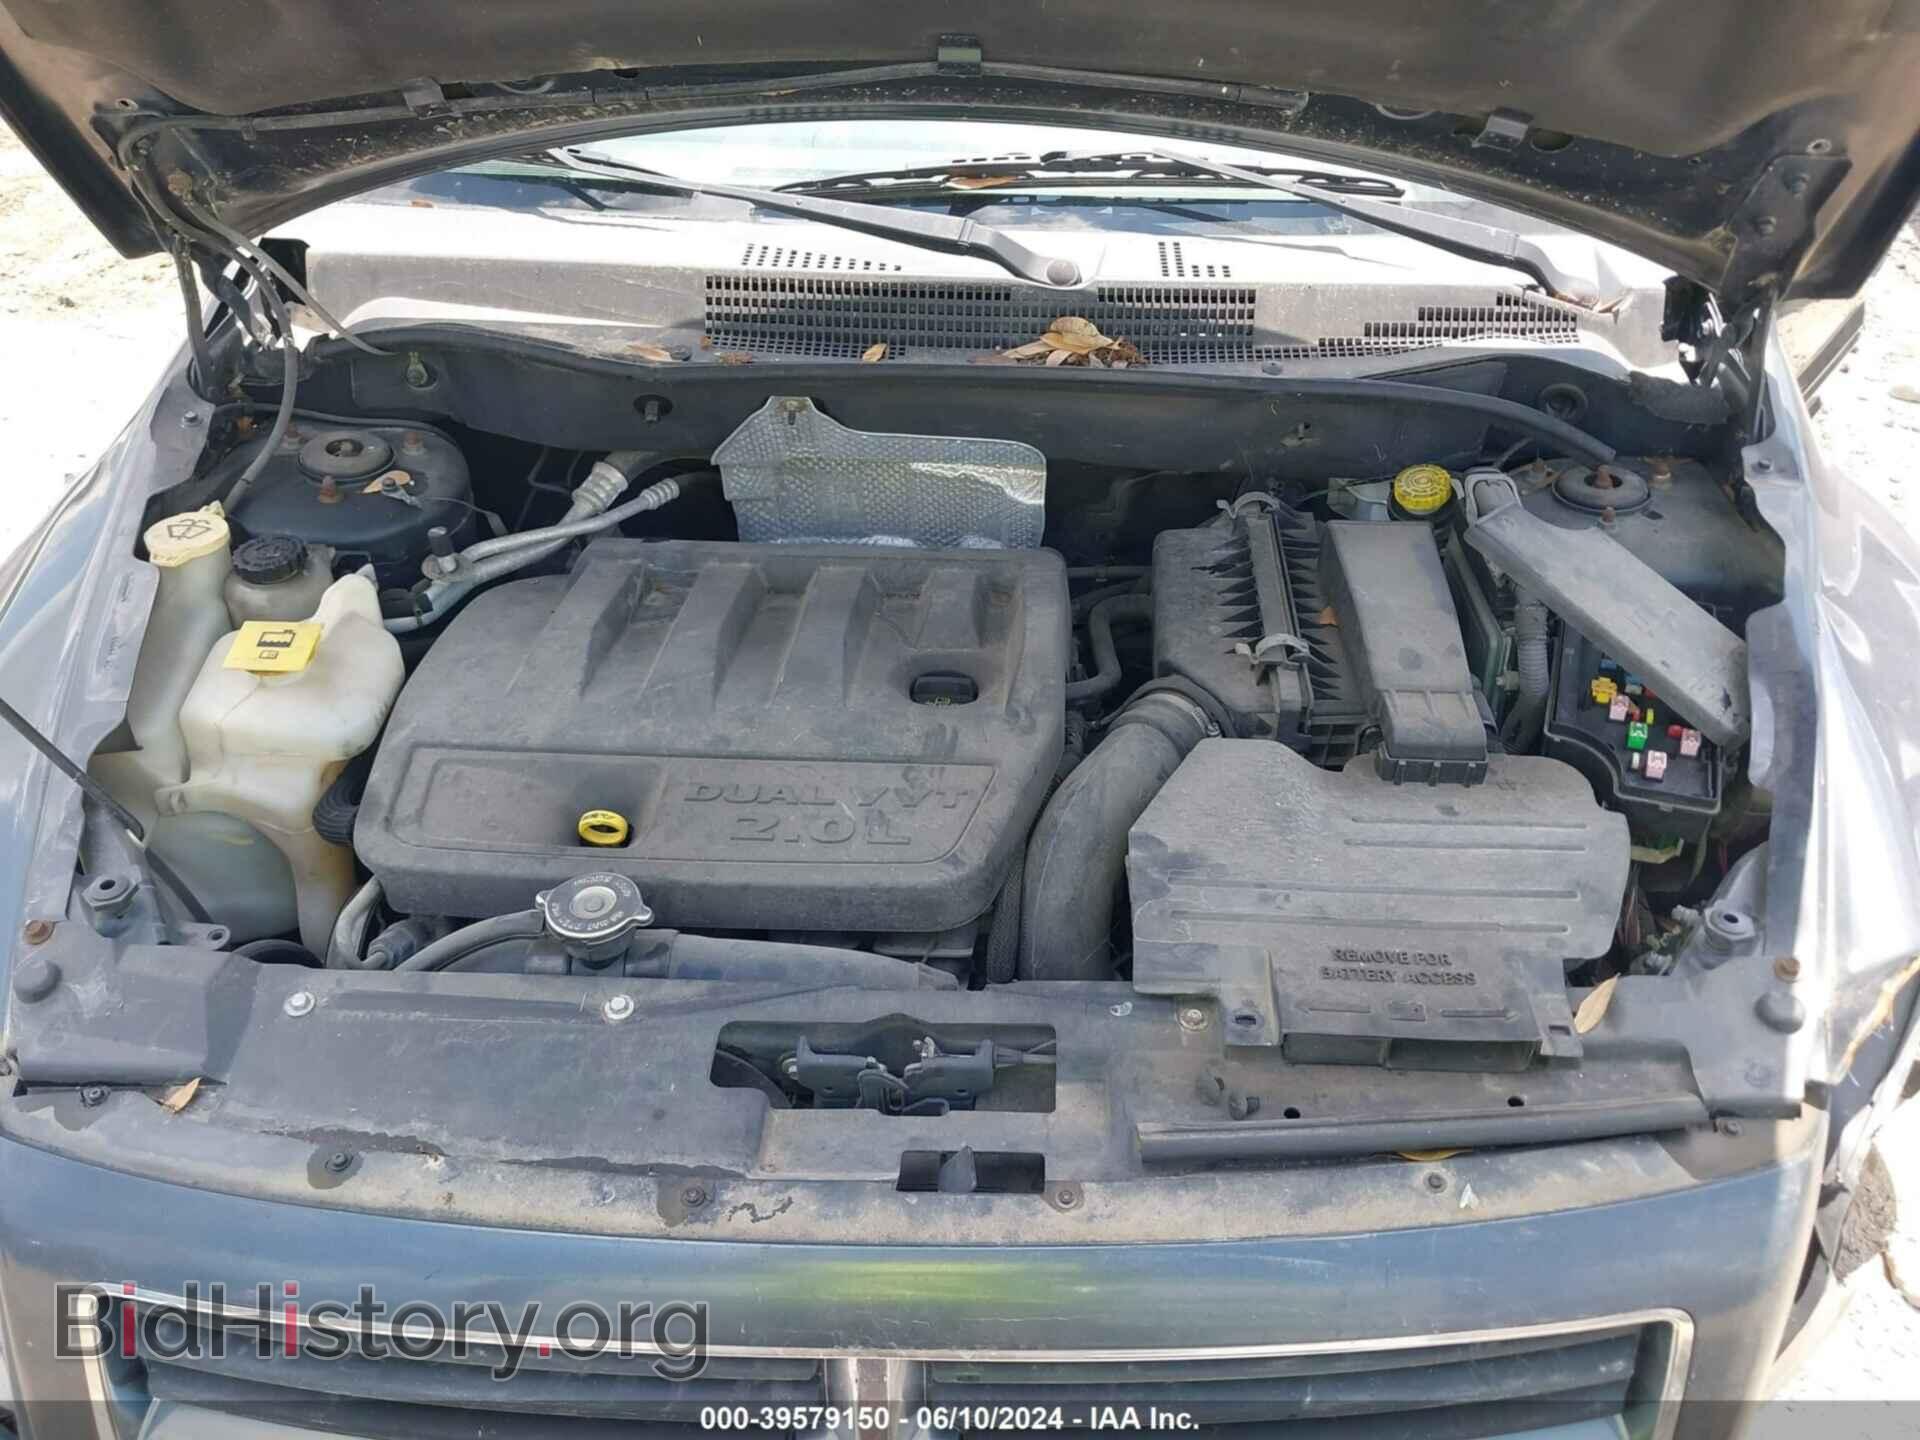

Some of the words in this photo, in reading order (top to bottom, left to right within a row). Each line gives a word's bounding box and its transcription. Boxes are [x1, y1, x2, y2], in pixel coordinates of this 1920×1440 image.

[683, 783, 837, 806] DUAL
[850, 786, 970, 809] VVT
[730, 816, 912, 846] 2.0L
[1333, 949, 1410, 966] REMOVE
[1415, 952, 1452, 967] FOR
[1320, 966, 1396, 983] BATTERY
[1403, 972, 1477, 986] ACCESS
